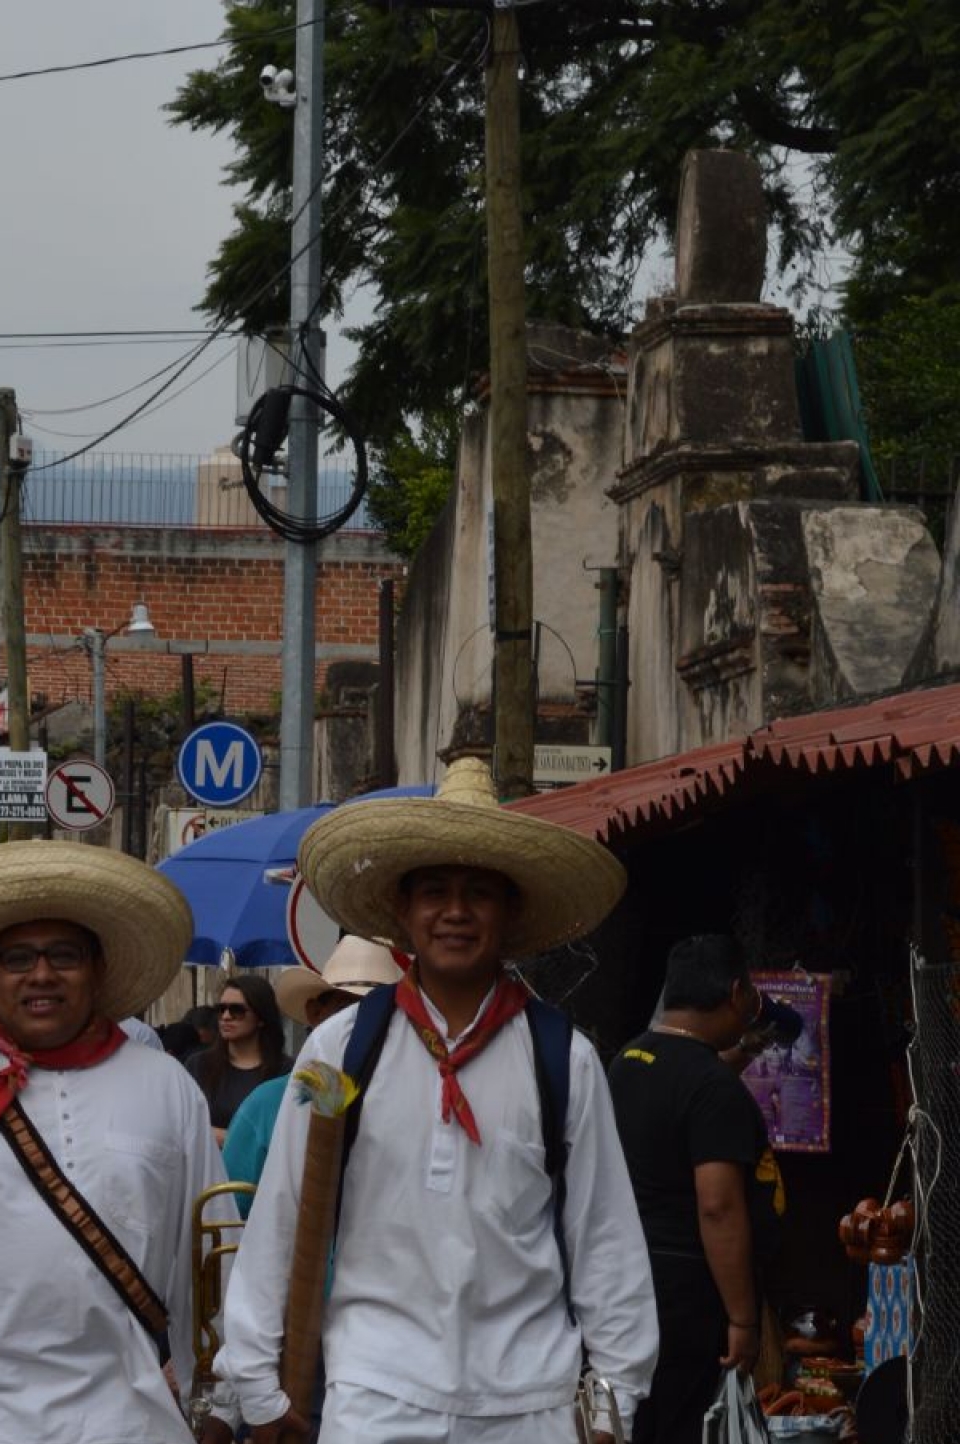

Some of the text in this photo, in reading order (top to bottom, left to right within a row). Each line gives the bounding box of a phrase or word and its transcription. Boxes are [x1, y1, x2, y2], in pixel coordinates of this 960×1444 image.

[195, 738, 244, 788] M
[34, 793, 45, 804] AL
[67, 775, 91, 813] E
